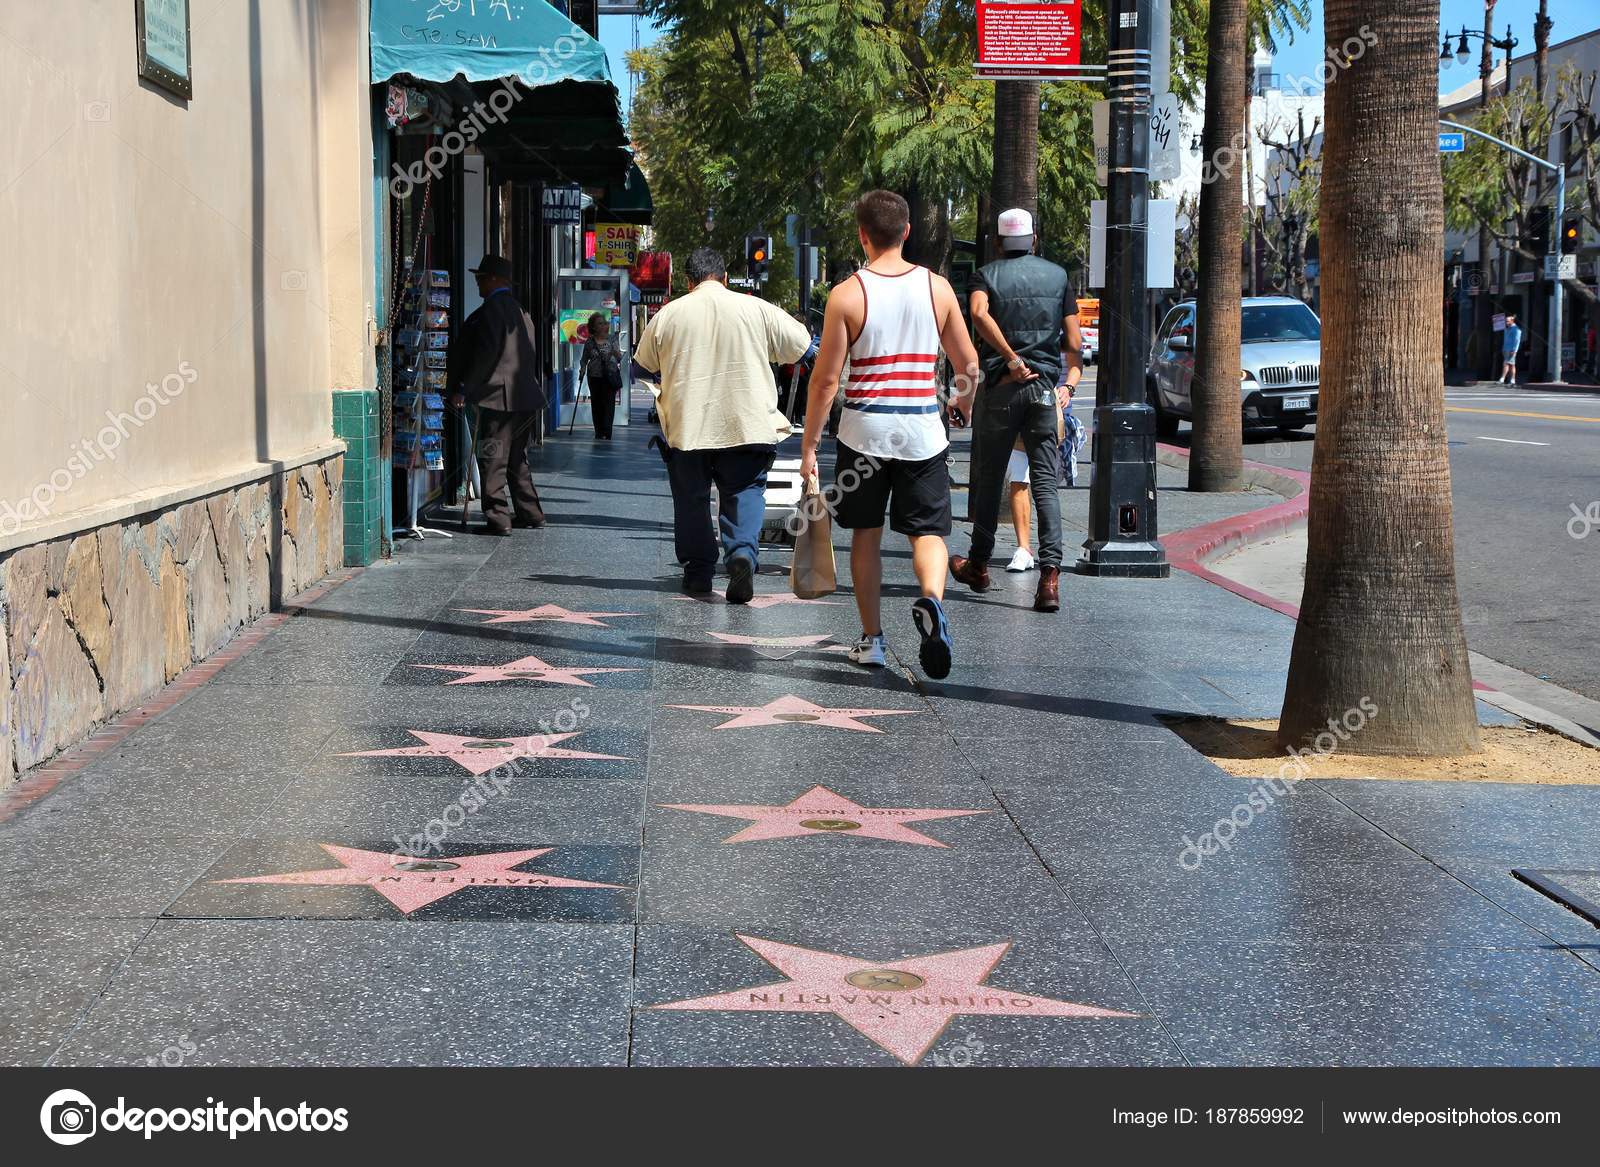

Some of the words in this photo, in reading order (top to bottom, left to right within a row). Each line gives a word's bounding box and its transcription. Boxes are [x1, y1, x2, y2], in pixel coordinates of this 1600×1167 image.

[543, 189, 580, 206] ATM
[544, 208, 580, 220] INSIDE
[606, 227, 640, 240] SALE
[422, 876, 550, 885] MARLEE
[749, 994, 892, 1005] MARTIN
[910, 996, 1033, 1008] QUINN
